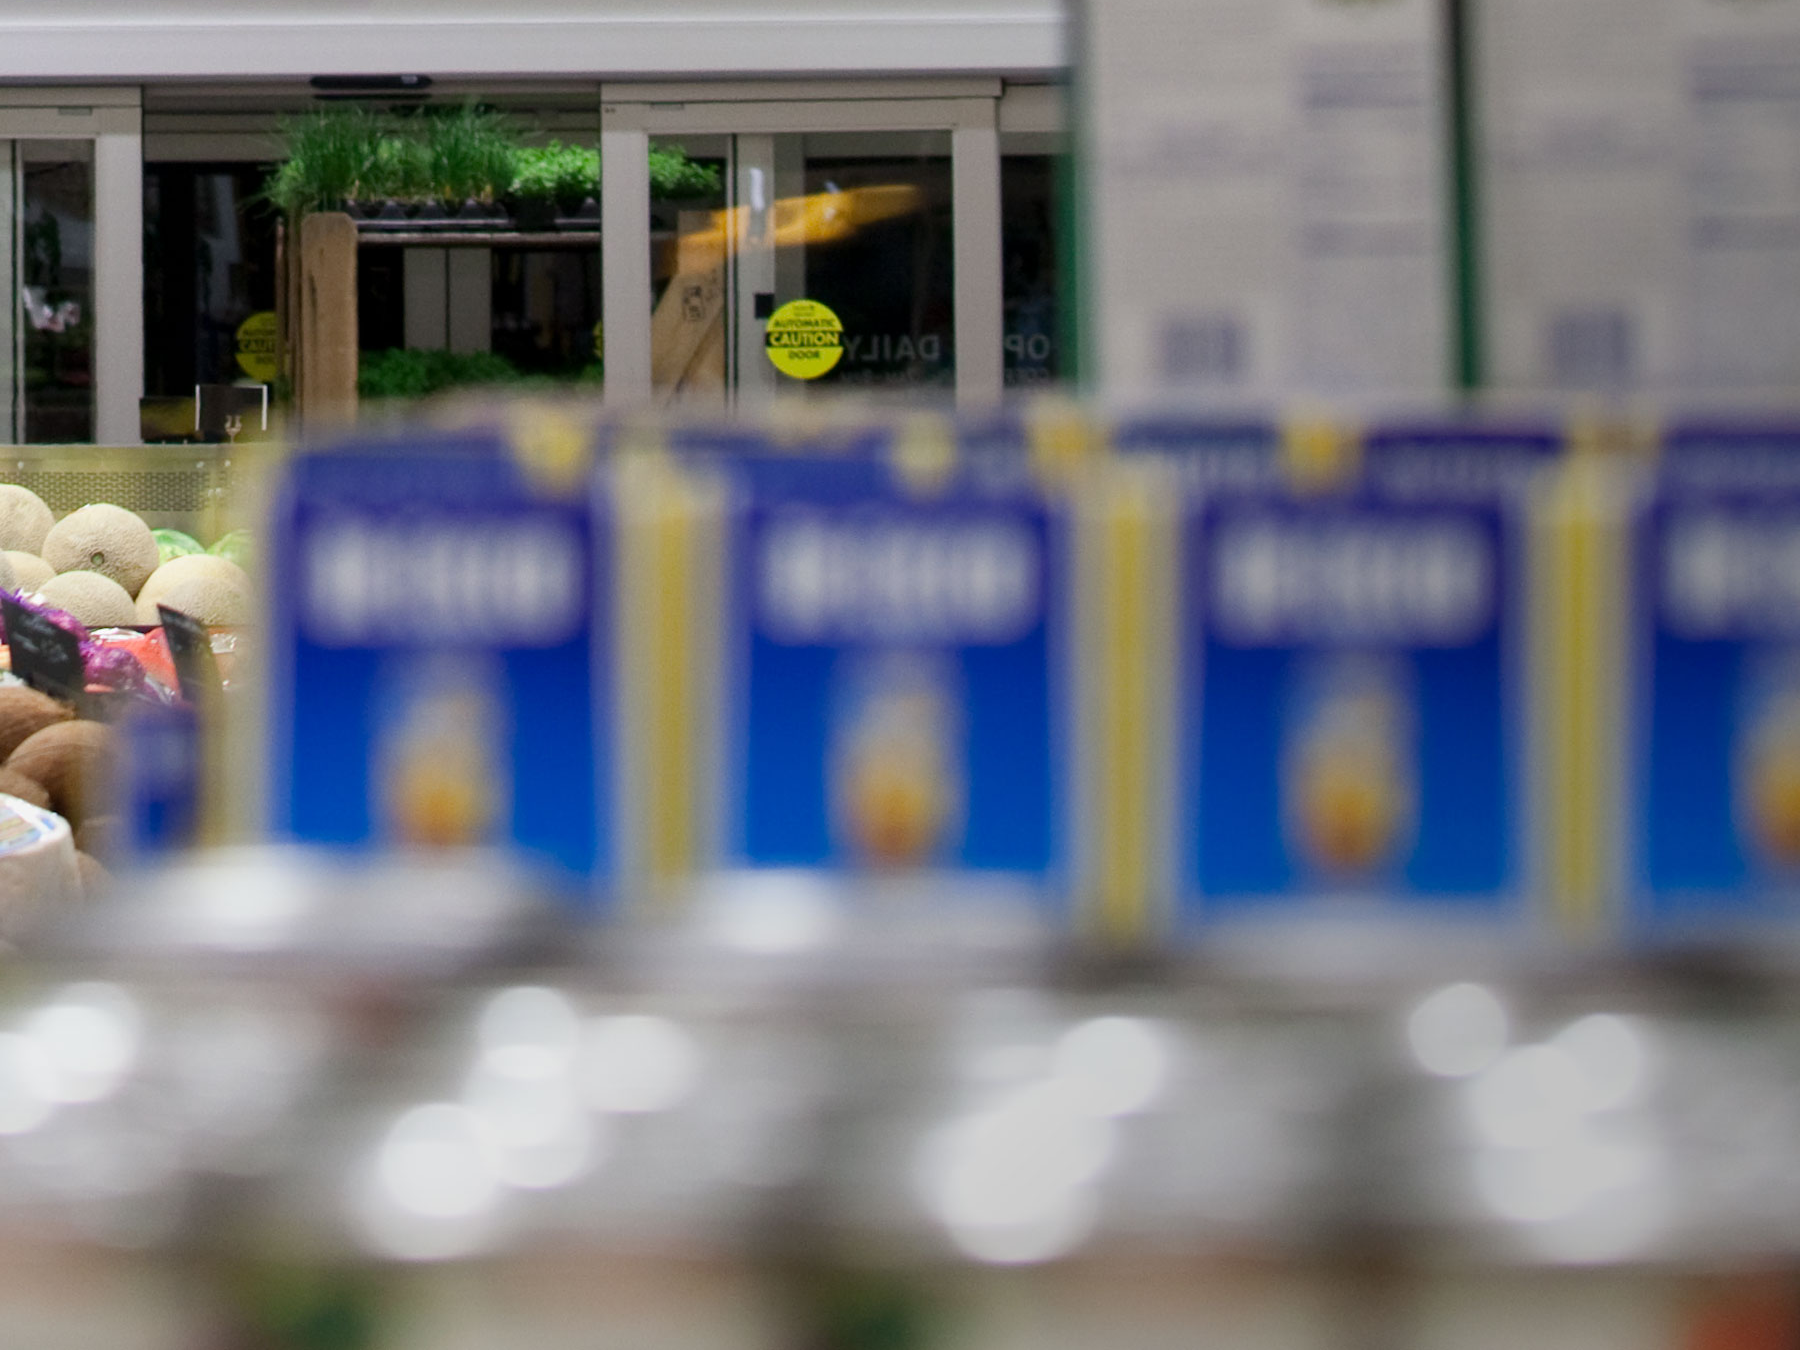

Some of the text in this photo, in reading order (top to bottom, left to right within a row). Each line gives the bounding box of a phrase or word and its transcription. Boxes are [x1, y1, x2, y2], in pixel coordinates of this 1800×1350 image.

[774, 319, 836, 327] AUTOMATIC
[769, 332, 839, 346] CAUTION
[788, 350, 820, 360] DOOR
